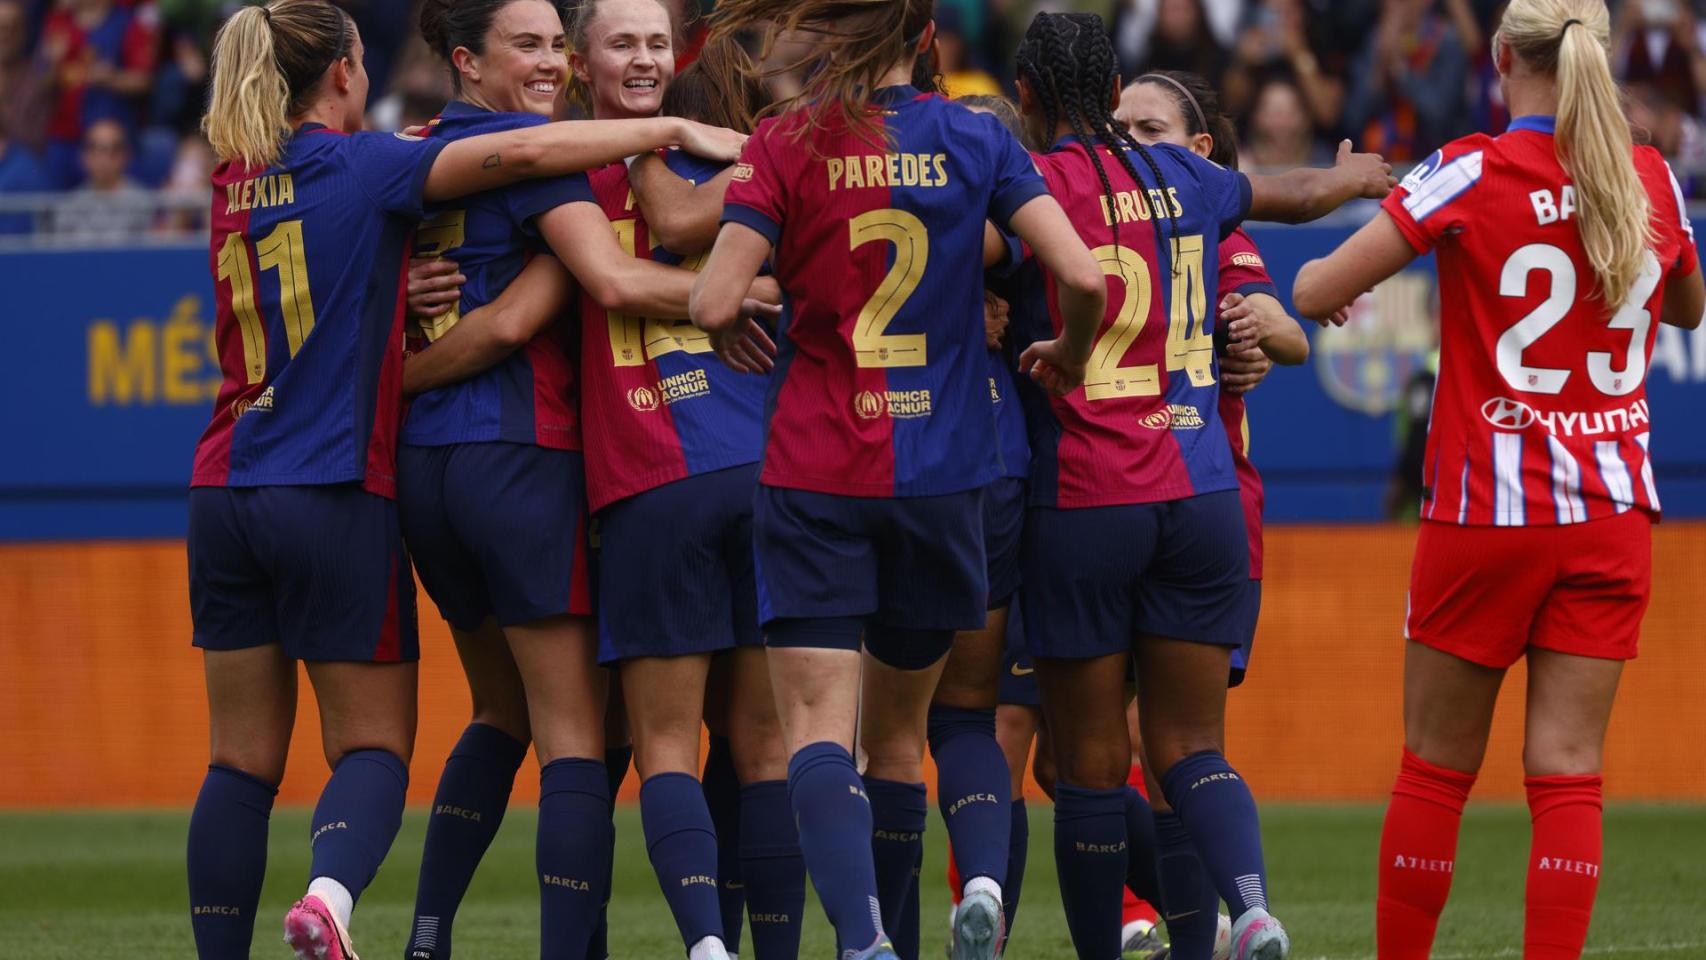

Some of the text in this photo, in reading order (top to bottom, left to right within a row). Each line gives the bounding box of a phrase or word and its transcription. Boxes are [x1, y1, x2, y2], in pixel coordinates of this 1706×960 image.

[827, 153, 948, 191] PAREDES
[225, 174, 294, 215] ALEXIA
[1529, 185, 1577, 226] BA
[217, 220, 316, 384] 11
[849, 208, 929, 368] 2
[1084, 235, 1217, 401] 24
[1496, 243, 1662, 396] 23
[657, 369, 706, 391] UNHCR
[662, 380, 710, 403] ACNUR
[884, 390, 931, 402] UNHCR
[888, 401, 931, 414] ACNUR
[1394, 854, 1453, 873] ATLETI
[1539, 856, 1599, 878] ATLETI
